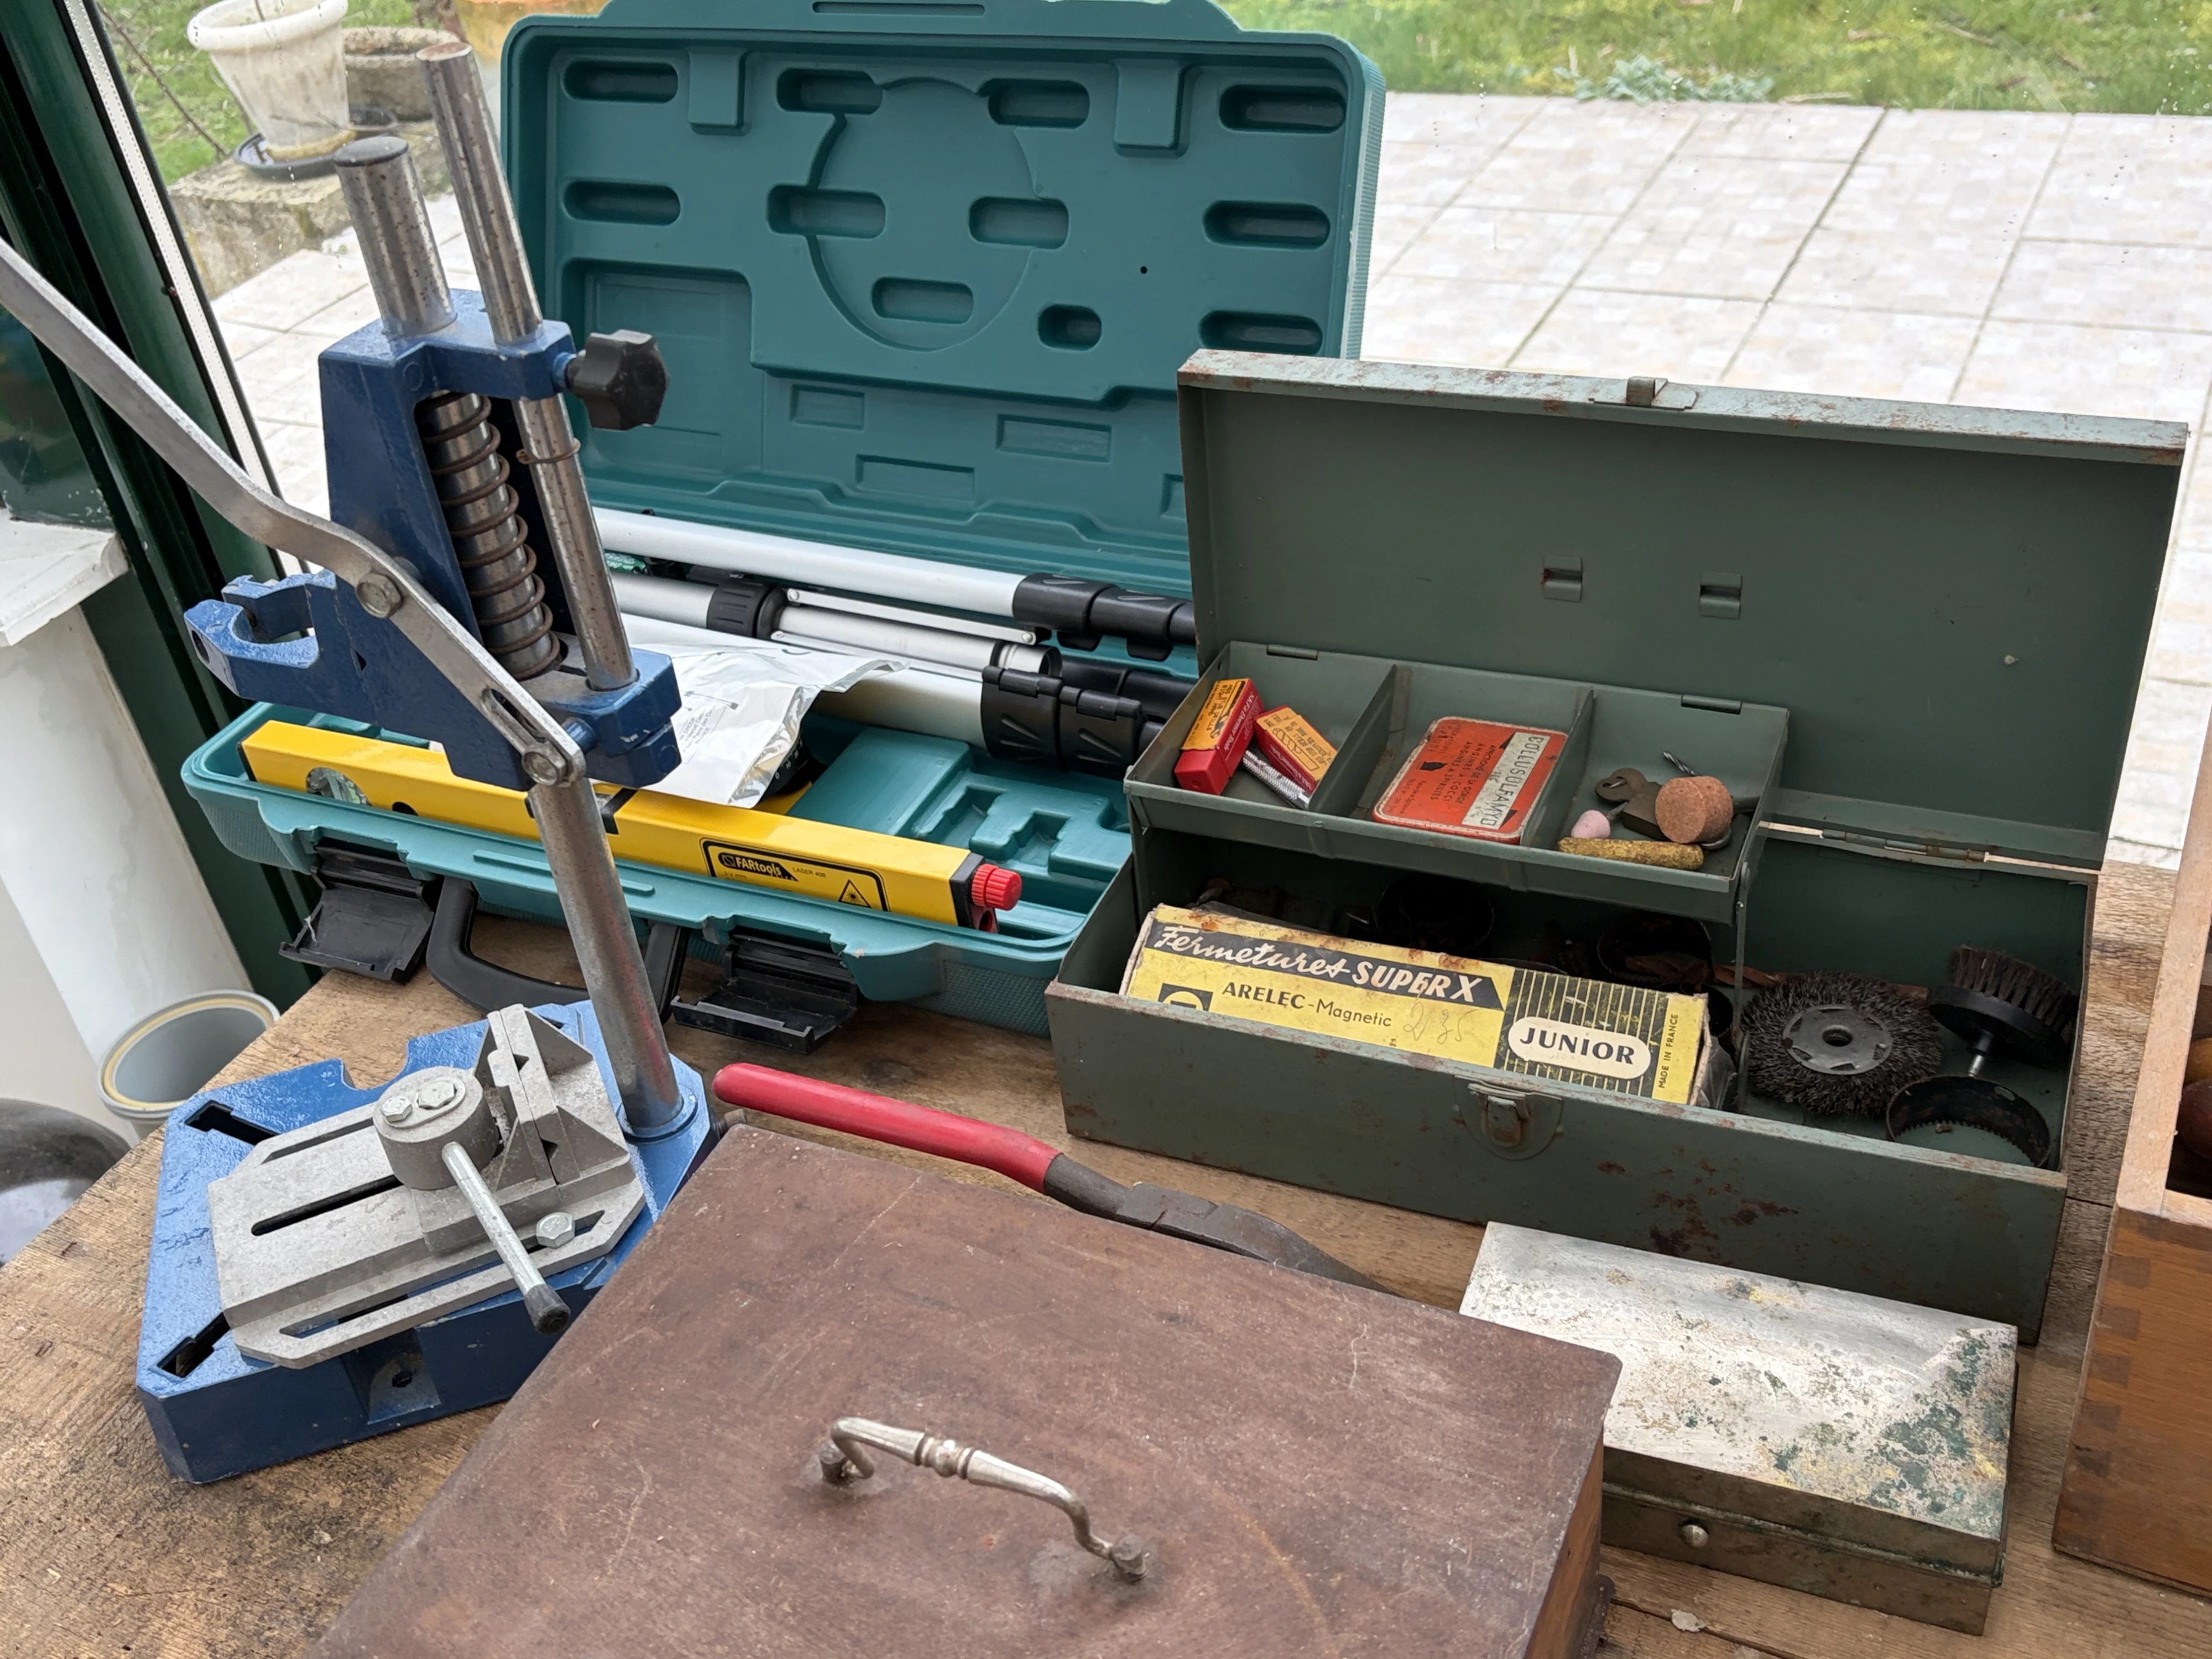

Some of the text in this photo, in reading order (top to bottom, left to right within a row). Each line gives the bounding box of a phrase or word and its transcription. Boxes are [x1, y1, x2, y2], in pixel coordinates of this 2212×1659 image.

[735, 857, 781, 875] FARtools
[792, 867, 813, 875] LASER
[1154, 925, 1350, 978] Fermetures
[1520, 1027, 1635, 1065] JUNIOR
[1658, 1014, 1678, 1089] MADE IN FRANCE
